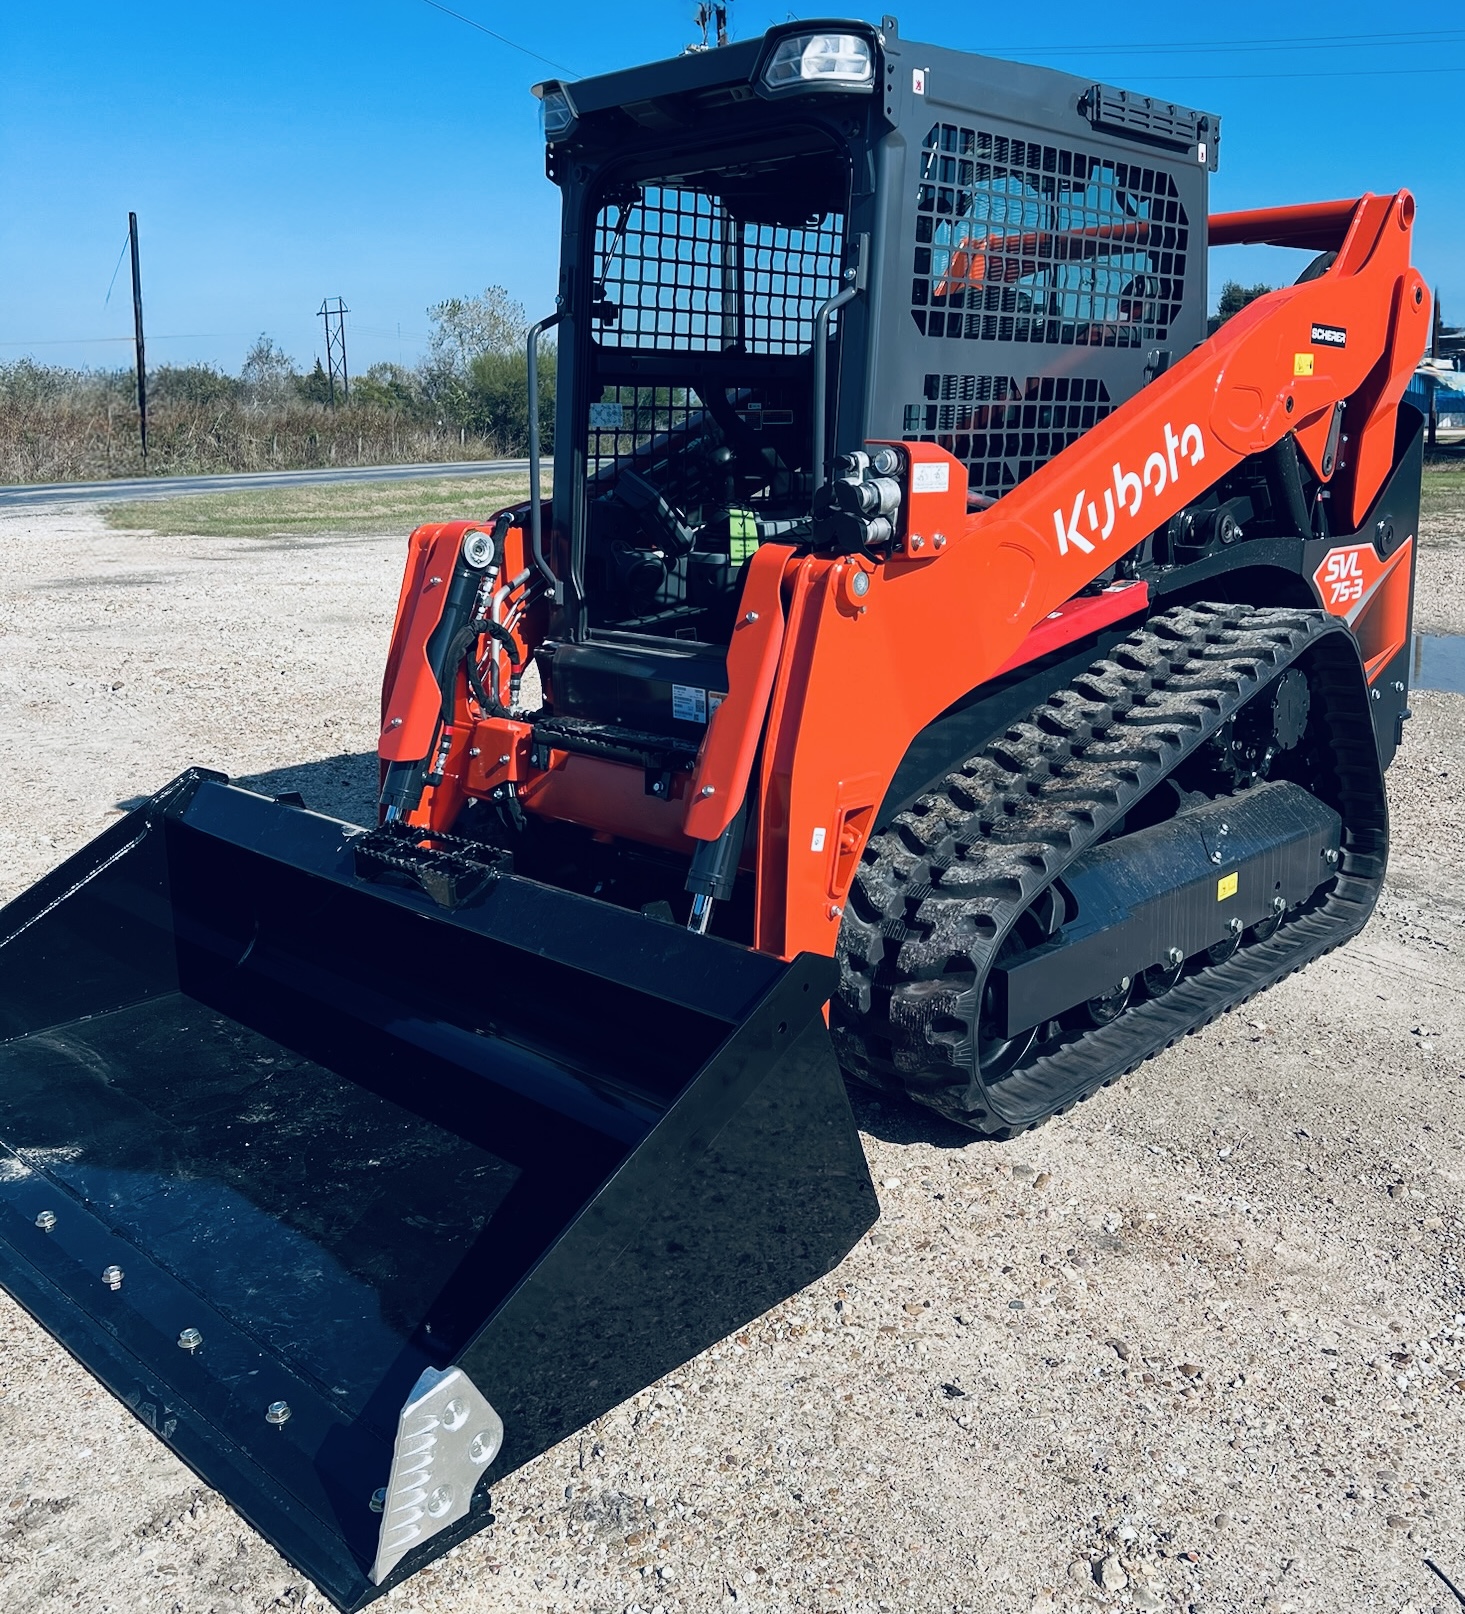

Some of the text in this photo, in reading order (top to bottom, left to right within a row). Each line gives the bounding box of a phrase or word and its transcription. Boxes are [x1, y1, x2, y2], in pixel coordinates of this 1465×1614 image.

[1312, 327, 1346, 343] SCHERER
[1053, 422, 1205, 556] Kubota
[1324, 551, 1363, 582] SVL
[1330, 578, 1364, 604] 75-3
